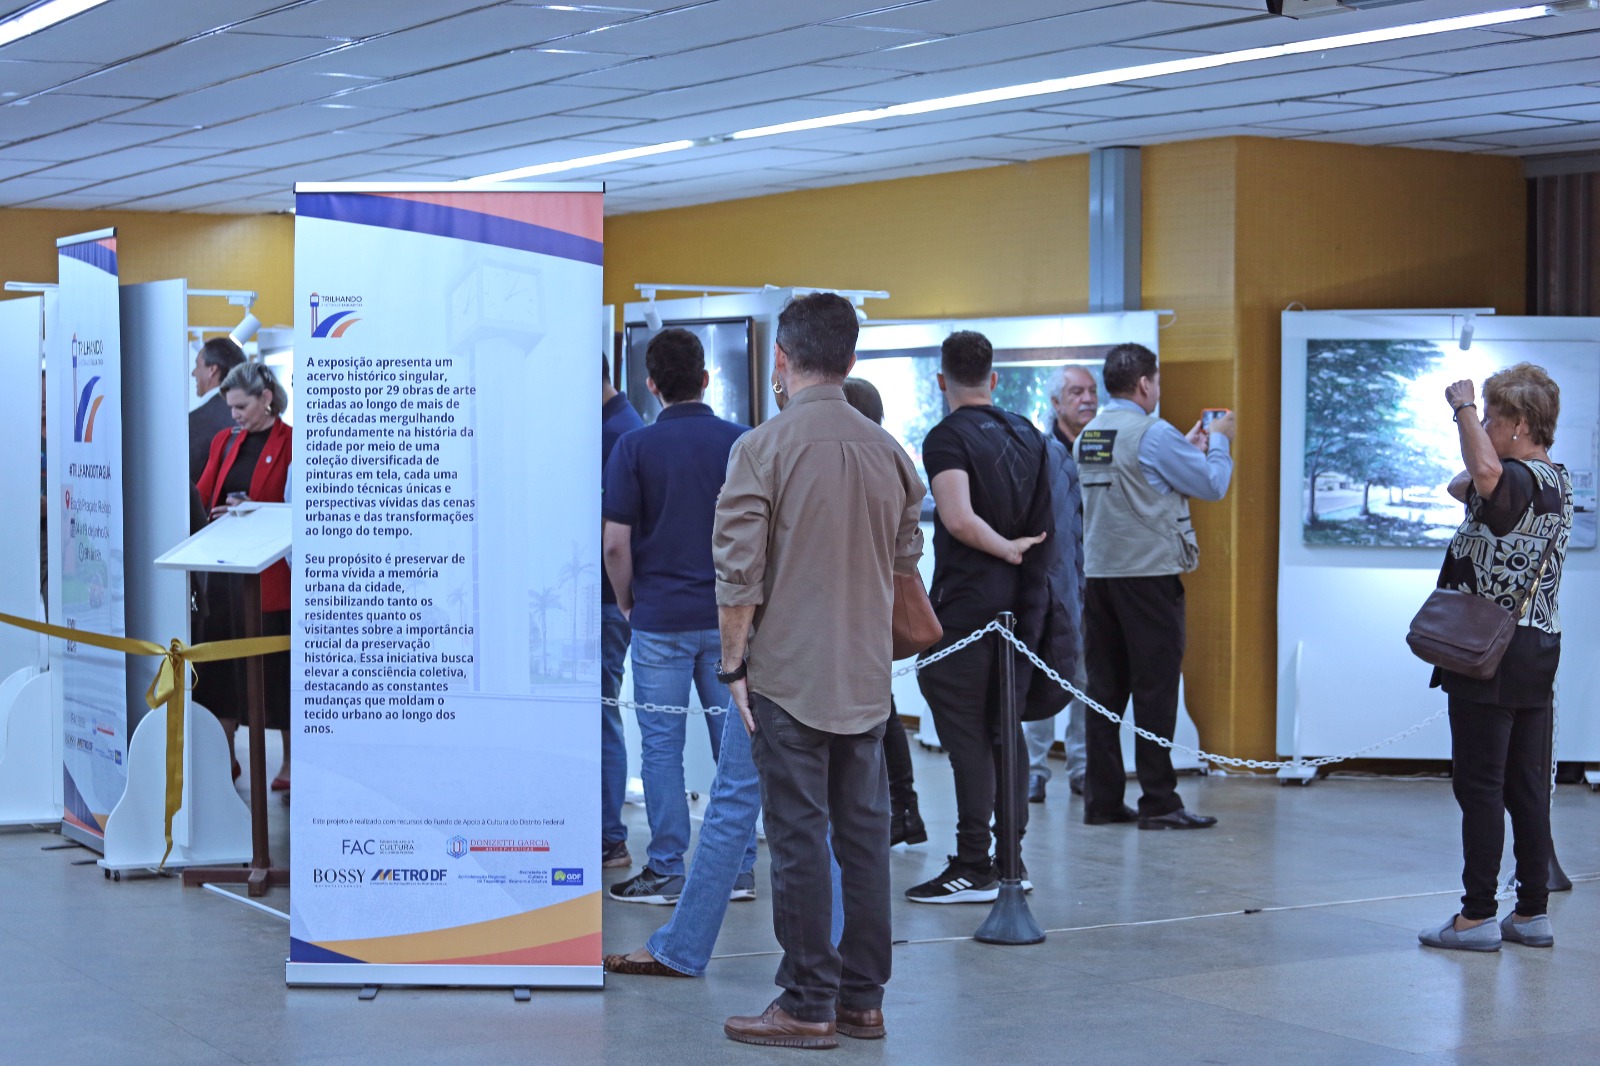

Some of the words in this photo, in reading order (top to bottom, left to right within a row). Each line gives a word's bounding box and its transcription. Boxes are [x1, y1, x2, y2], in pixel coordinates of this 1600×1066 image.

[306, 357, 315, 367] A
[317, 356, 373, 370] exposição
[375, 358, 432, 370] apresenta
[435, 359, 453, 367] um
[306, 373, 344, 381] acervo
[347, 370, 396, 381] histórico
[399, 370, 447, 384] singular,
[306, 386, 362, 398] composto
[364, 387, 384, 398] por
[386, 385, 400, 395] 29
[402, 384, 434, 395] obras
[436, 384, 450, 395] de
[453, 386, 476, 395] arte
[306, 398, 347, 409] criadas
[349, 401, 364, 409] ao
[366, 398, 398, 412] longo
[400, 398, 414, 409] de
[417, 398, 443, 409] mais
[446, 398, 460, 409] de
[306, 412, 328, 423] três
[331, 412, 377, 423] décadas
[379, 412, 455, 426] mergulhando
[306, 426, 395, 440] profundamente
[397, 429, 411, 437] na
[414, 426, 457, 437] história
[460, 426, 474, 437] da
[306, 440, 343, 451] cidade
[346, 443, 365, 454] por
[368, 440, 396, 451] meio
[398, 440, 412, 451] de
[415, 443, 440, 451] uma
[306, 454, 348, 468] coleção
[351, 454, 423, 466] diversificada
[425, 454, 440, 465] de
[306, 468, 353, 482] pinturas
[376, 468, 401, 481] tela,
[404, 468, 430, 480] cada
[433, 471, 458, 479] uma
[305, 483, 354, 494] exibindo
[357, 482, 403, 494] técnicas
[406, 482, 442, 494] únicas
[444, 485, 451, 493] e
[305, 497, 376, 511] perspectivas
[379, 496, 418, 508] vívidas
[421, 497, 440, 508] das
[443, 499, 475, 507] cenas
[305, 511, 351, 522] urbanas
[354, 513, 361, 522] e
[363, 511, 383, 522] das
[386, 511, 474, 525] transformações
[305, 527, 319, 536] ao
[322, 525, 353, 539] longo
[356, 525, 370, 536] do
[373, 526, 412, 539] tempo.
[305, 553, 325, 564] Seu
[328, 553, 382, 567] propósito
[385, 553, 392, 564] é
[394, 555, 449, 567] preservar
[451, 553, 465, 564] de
[305, 567, 339, 578] forma
[341, 567, 375, 578] vívida
[388, 567, 438, 578] memória
[305, 581, 345, 592] urbana
[348, 581, 362, 592] da
[364, 581, 405, 594] cidade,
[305, 595, 384, 606] sensibilizando
[387, 597, 418, 606] tanto
[420, 598, 433, 606] os
[305, 610, 363, 620] residentes
[366, 611, 406, 623] quanto
[409, 612, 422, 621] os
[304, 623, 359, 635] visitantes
[362, 623, 393, 635] sobre
[396, 626, 403, 635] a
[406, 624, 474, 638] importância
[304, 638, 342, 649] crucial
[345, 638, 359, 649] da
[362, 638, 430, 652] preservação
[304, 652, 357, 663] histórica.
[360, 653, 384, 663] Essa
[387, 652, 438, 663] iniciativa
[441, 652, 474, 663] busca
[304, 666, 339, 677] elevar
[342, 669, 349, 677] a
[351, 666, 416, 677] consciência
[419, 666, 467, 679] coletiva,
[304, 680, 369, 691] destacando
[371, 683, 384, 691] as
[387, 682, 448, 691] constantes
[304, 694, 362, 708] mudanças
[364, 697, 386, 708] que
[389, 694, 435, 706] moldam
[437, 697, 445, 706] o
[304, 708, 339, 719] tecido
[342, 709, 382, 720] urbano
[385, 711, 399, 720] ao
[402, 709, 433, 723] longo
[436, 709, 456, 720] dos
[304, 725, 333, 734] anos.
[342, 839, 375, 855] FAC
[314, 868, 366, 883] BOSSY
[431, 869, 447, 881] DF
